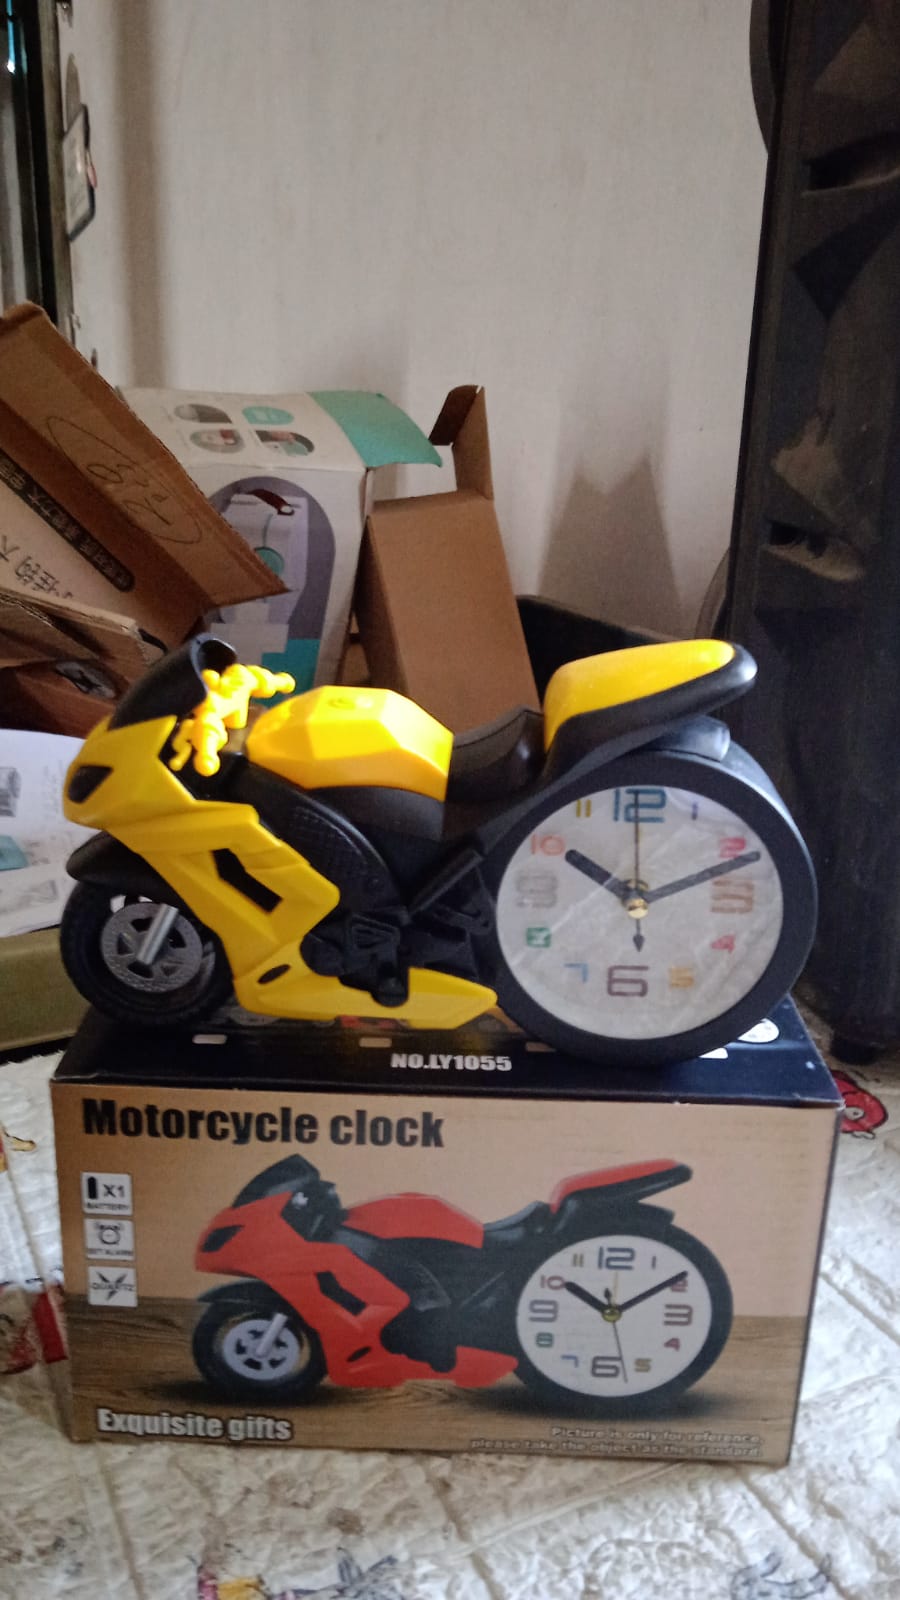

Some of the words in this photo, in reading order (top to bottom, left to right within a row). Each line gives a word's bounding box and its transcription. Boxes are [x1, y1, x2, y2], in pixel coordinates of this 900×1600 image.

[576, 799, 592, 818] 11
[613, 788, 668, 823] 12
[691, 803, 699, 821] 1
[531, 834, 566, 856] 10
[719, 836, 747, 859] 2
[710, 877, 755, 914] 3
[711, 934, 736, 954] 4
[564, 963, 590, 984] 7
[607, 965, 649, 997] 6
[668, 966, 695, 989] 5
[390, 1053, 512, 1071] NO.LY1055
[82, 1099, 319, 1145] Motorcycle
[329, 1110, 444, 1147] clock
[572, 1254, 584, 1267] 11
[597, 1246, 635, 1271] 12
[651, 1256, 656, 1269] 1
[540, 1275, 565, 1290] 10
[528, 1299, 558, 1323] 9
[663, 1304, 693, 1326] 3
[535, 1332, 554, 1348] 8
[664, 1337, 680, 1351] 4
[561, 1354, 579, 1368] 7
[590, 1356, 622, 1378] 6
[634, 1358, 652, 1373] 5
[97, 1408, 223, 1437] Exquisite
[227, 1415, 293, 1441] gifts
[471, 1439, 519, 1451] please
[561, 1441, 586, 1451] the
[551, 1427, 606, 1439] Picture
[627, 1431, 658, 1443] only
[663, 1431, 682, 1442] for
